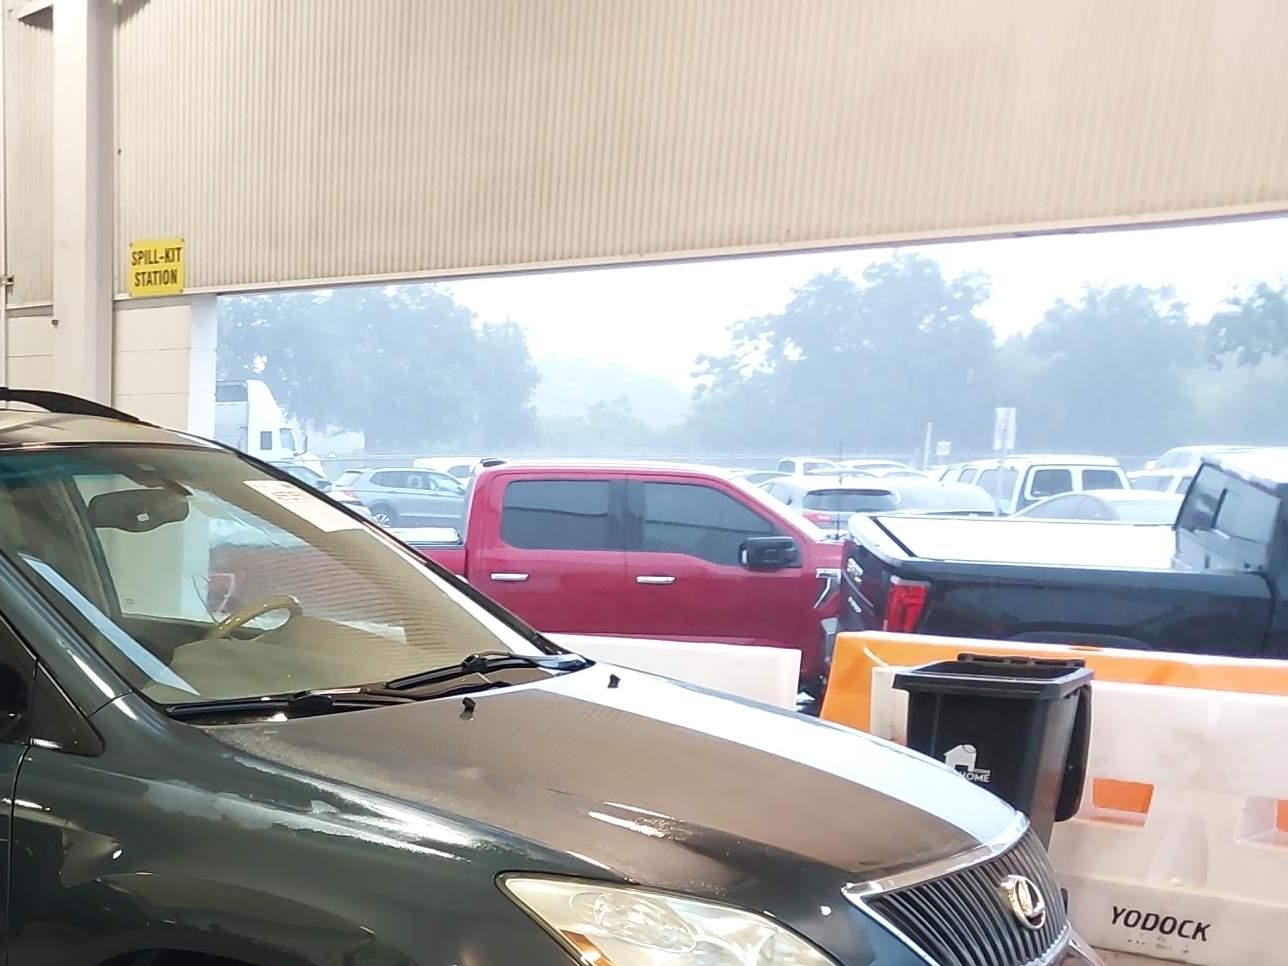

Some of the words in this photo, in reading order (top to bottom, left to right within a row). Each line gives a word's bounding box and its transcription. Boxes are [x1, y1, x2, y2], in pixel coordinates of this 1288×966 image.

[131, 247, 182, 266] SPILL-KIT
[134, 269, 178, 287] STATION
[1112, 905, 1211, 942] YODOCK
